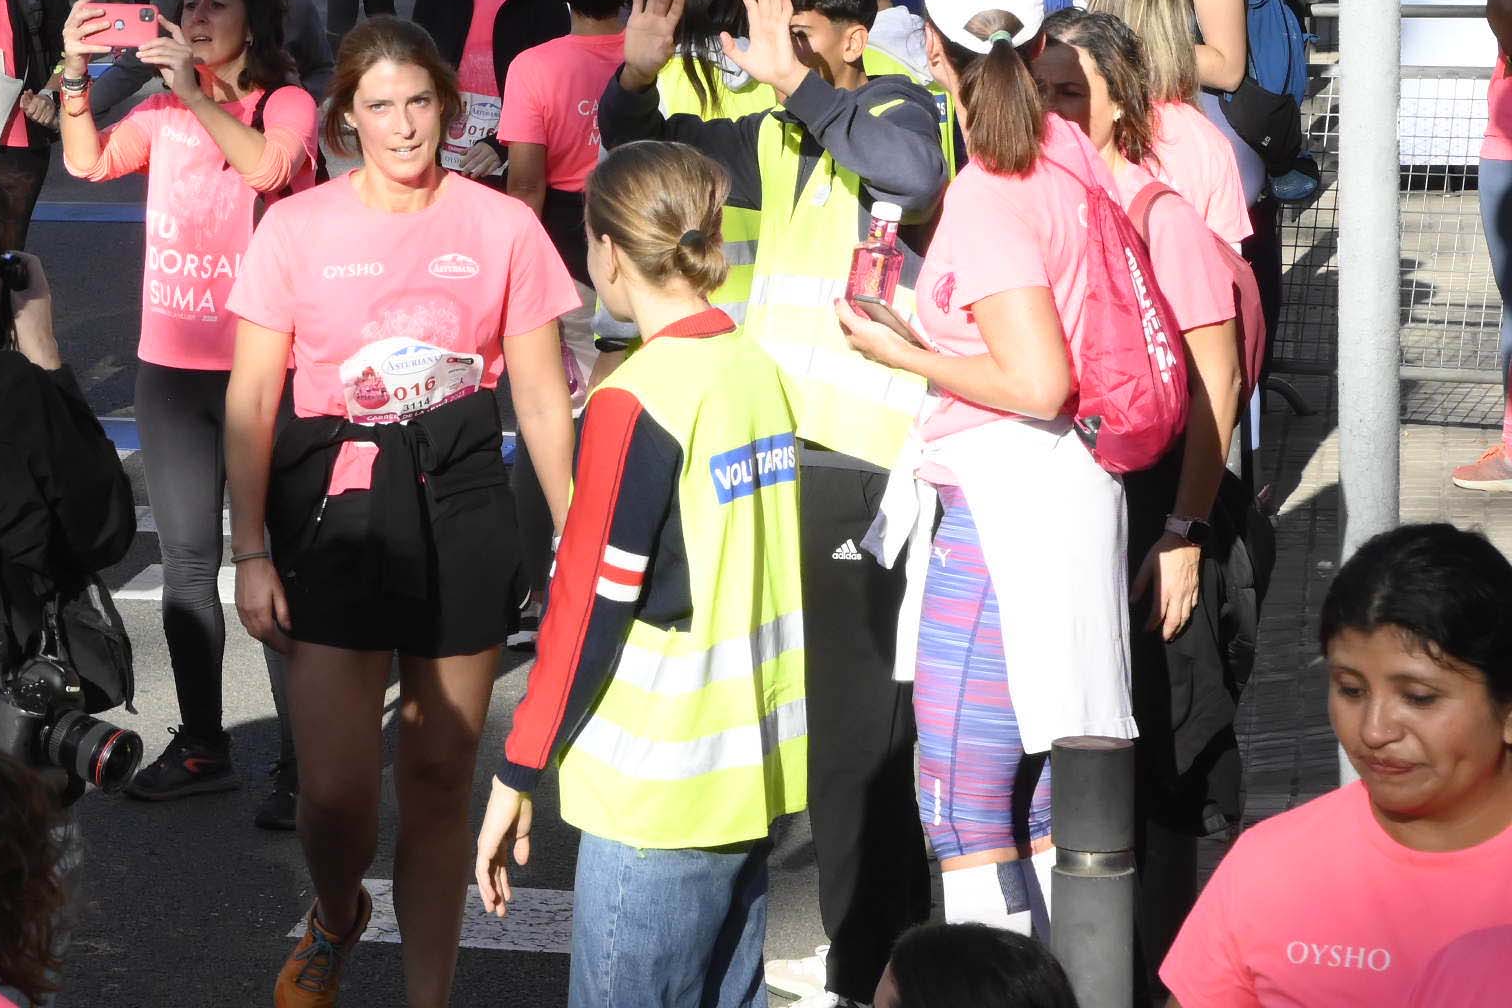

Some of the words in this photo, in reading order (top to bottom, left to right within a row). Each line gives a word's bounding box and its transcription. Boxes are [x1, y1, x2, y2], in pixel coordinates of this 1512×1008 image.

[149, 209, 177, 239] TU
[323, 261, 385, 279] OYSHO
[150, 279, 217, 313] SUMA
[393, 376, 437, 401] 016
[402, 397, 432, 412] 3114
[832, 551, 862, 561] adidas
[1286, 939, 1392, 974] OYSHO
